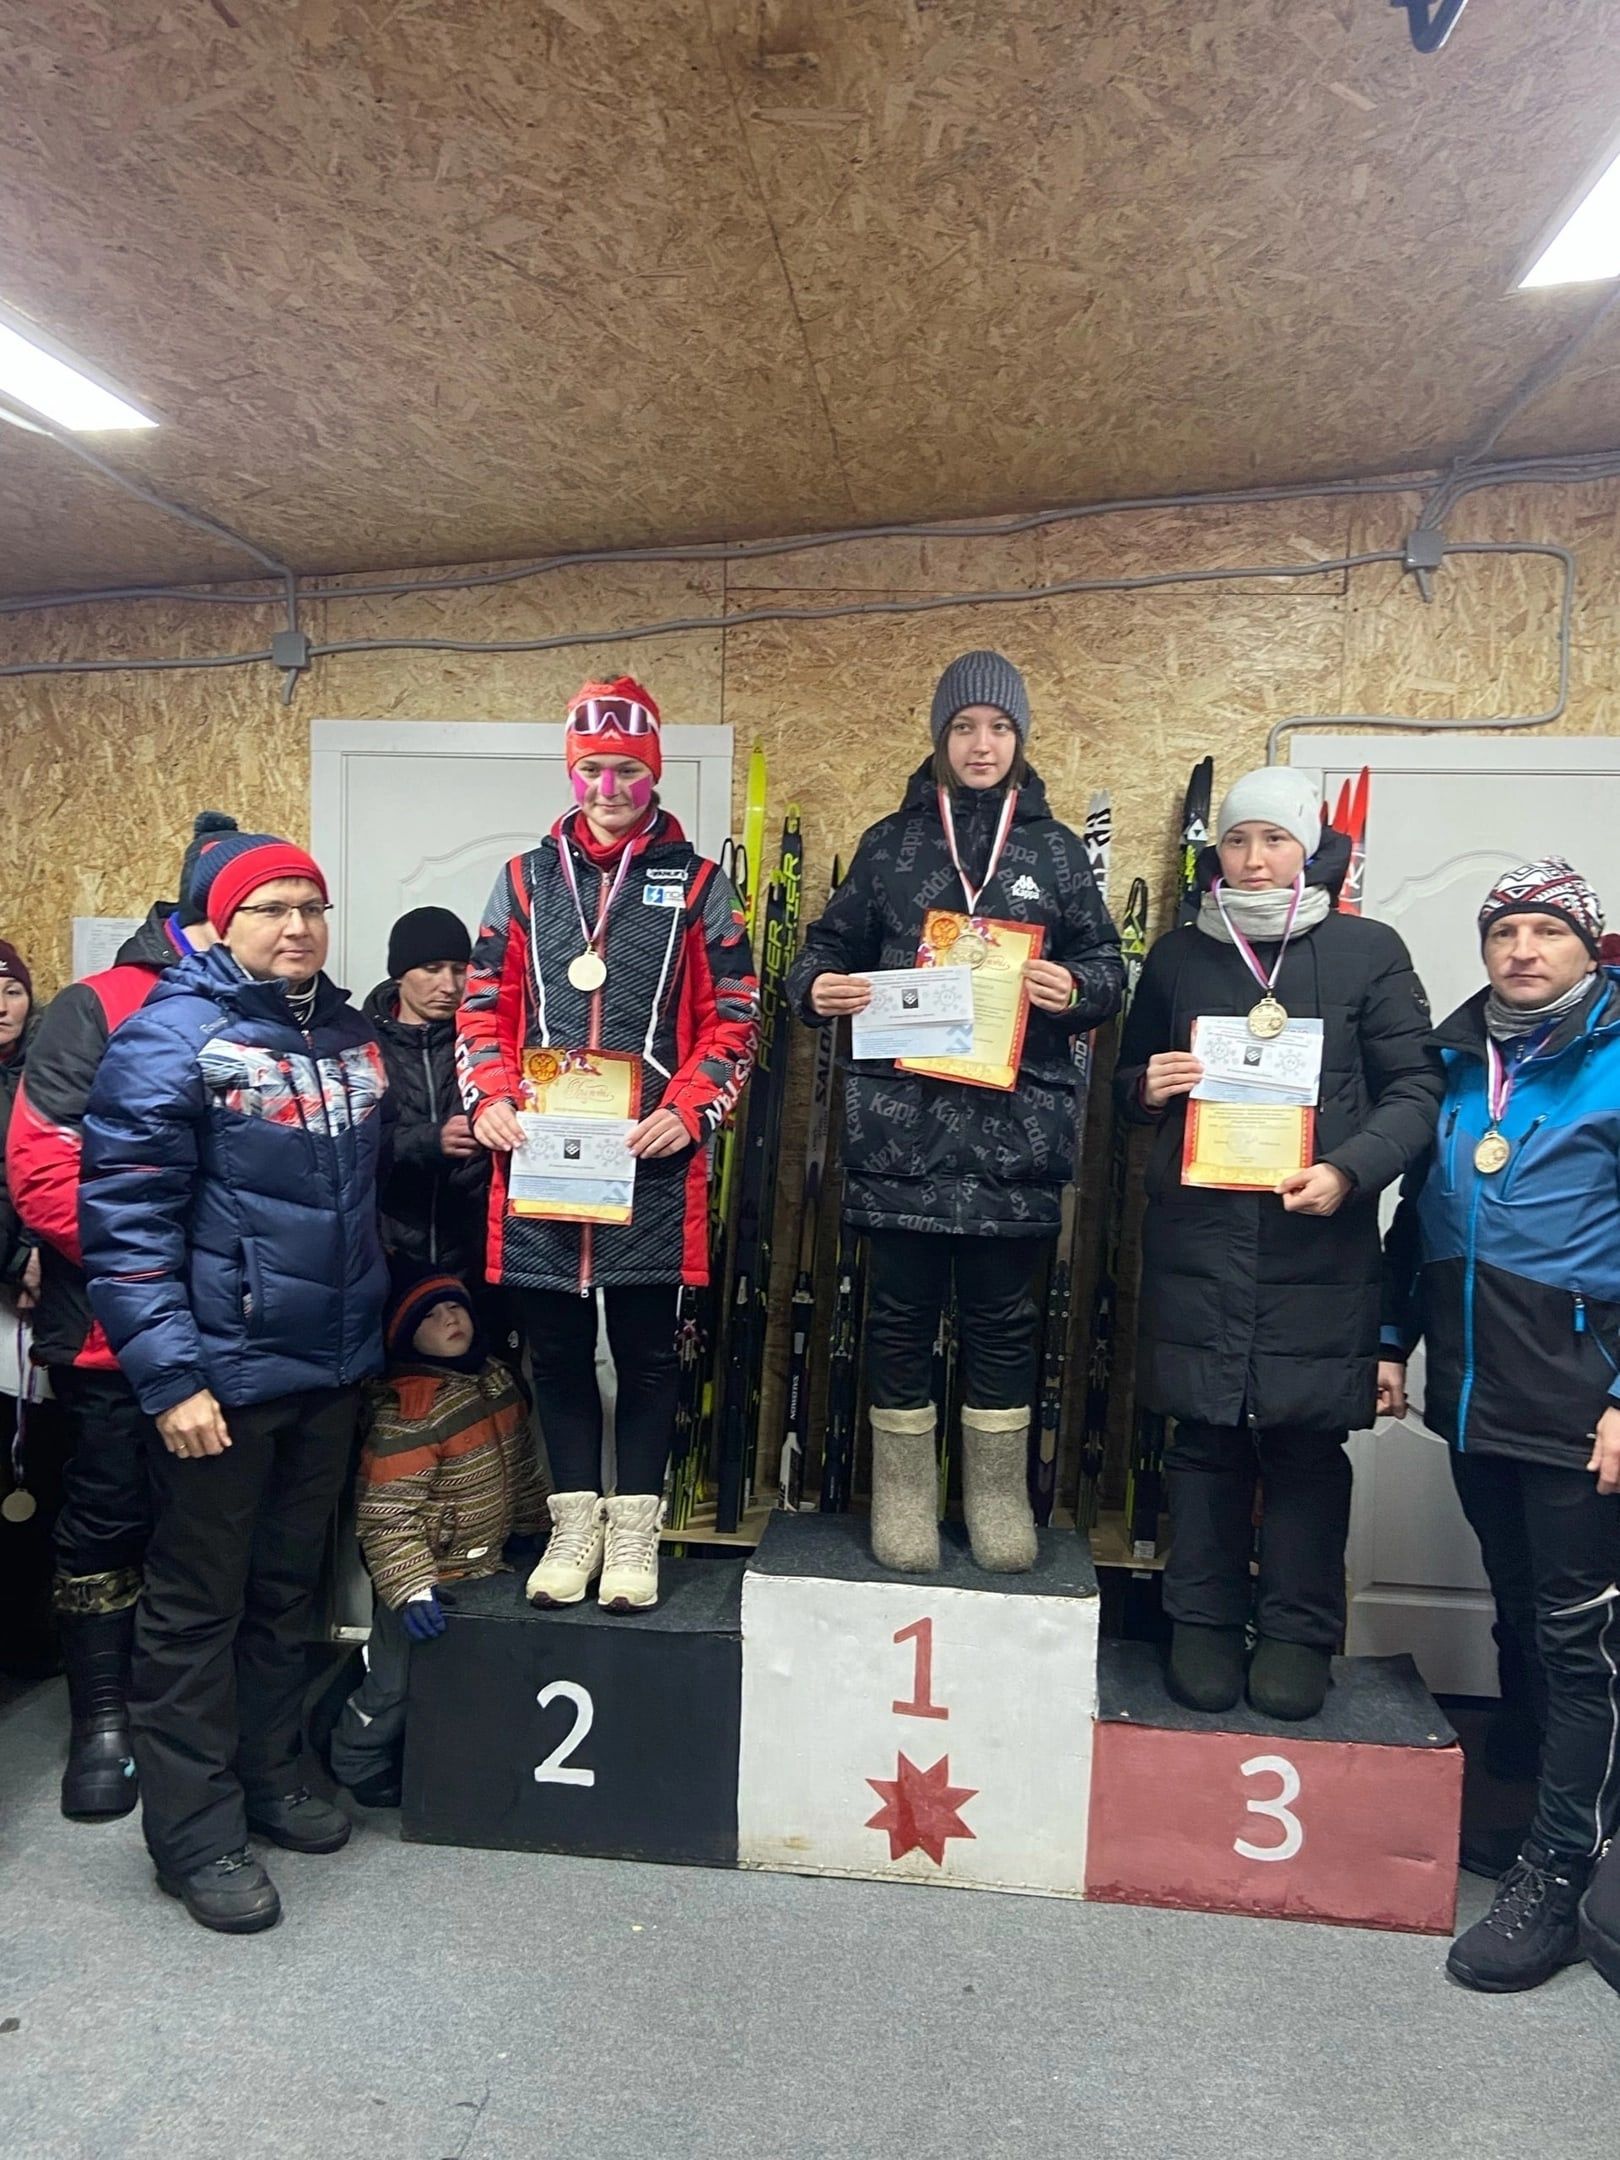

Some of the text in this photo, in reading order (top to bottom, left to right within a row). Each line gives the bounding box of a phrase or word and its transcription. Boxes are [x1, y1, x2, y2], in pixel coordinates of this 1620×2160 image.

[895, 819, 925, 873] Kappa
[1011, 888, 1040, 900] Kappa
[758, 920, 784, 1073] FISCHER
[868, 1092, 922, 1129] Kapp
[892, 1616, 950, 1721] 1
[534, 1680, 596, 1787] 2
[1232, 1755, 1305, 1862] 3
